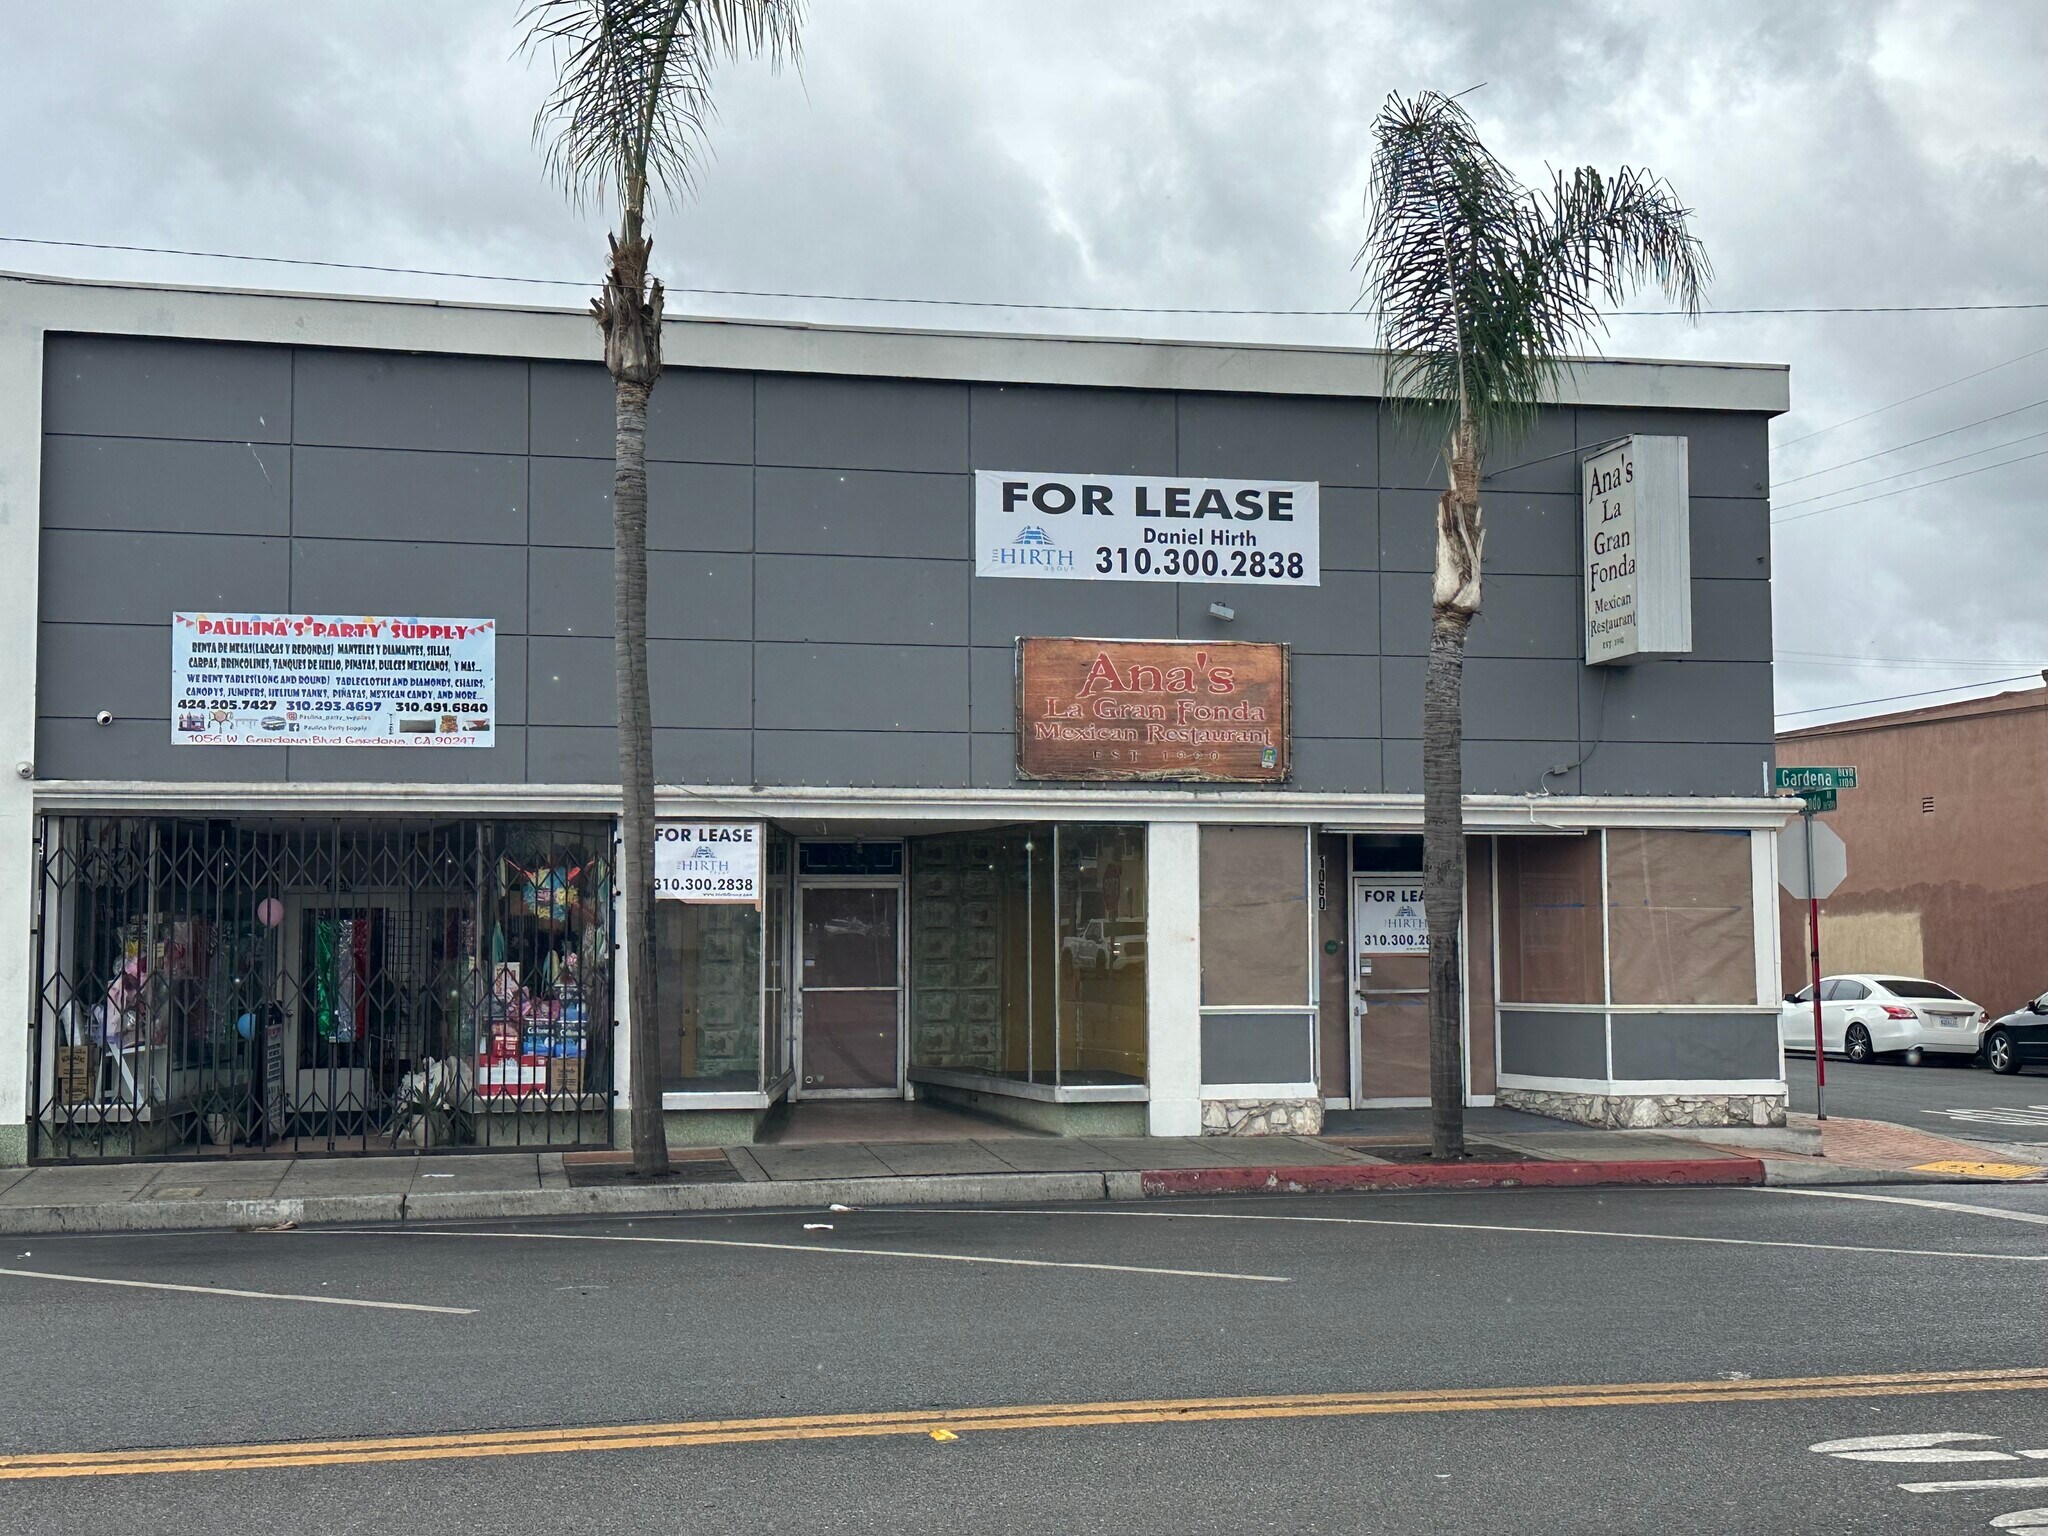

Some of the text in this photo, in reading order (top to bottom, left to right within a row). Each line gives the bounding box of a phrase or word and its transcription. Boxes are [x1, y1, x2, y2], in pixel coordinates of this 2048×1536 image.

[1589, 454, 1633, 504] Ana's
[1002, 481, 1294, 522] FOR LEASE
[1601, 498, 1621, 524] La
[1143, 527, 1257, 547] Daniel Hirth
[1594, 529, 1630, 555] Gran
[1001, 548, 1073, 565] HIRTH
[1095, 546, 1304, 579] 310.300.2838
[1590, 553, 1636, 593] Fonda
[1594, 594, 1632, 615] Mexican
[198, 620, 468, 639] PAULINA'S PARTY SUPPLY
[1590, 610, 1636, 637] Restaurant
[192, 642, 217, 653] RENTA
[218, 642, 228, 653] DE
[285, 644, 290, 654] Y
[292, 644, 334, 656] REDONDAS)
[337, 644, 374, 655] MANTELES
[376, 644, 381, 655] Y
[382, 645, 425, 657] DIAMANTES,
[427, 645, 452, 658] SILLAS,
[188, 657, 220, 669] CARPAS,
[220, 657, 272, 671] BRINCOLINES,
[273, 658, 306, 671] TANQUES
[308, 659, 318, 670] DE
[319, 659, 343, 672] HELIO,
[379, 660, 406, 671] DULCES
[407, 660, 451, 673] MEXICANOS,
[454, 660, 460, 671] Y
[187, 674, 200, 683] WE
[202, 674, 223, 683] RENT
[280, 675, 297, 684] AND
[299, 675, 330, 685] ROUND)
[336, 677, 391, 686] TABLECLOTHS
[392, 678, 408, 686] AND
[410, 678, 453, 688] DIAMONDS,
[455, 678, 485, 688] CHAIRS,
[1075, 651, 1235, 699] Ana's
[186, 687, 226, 697] CANOPYS,
[227, 687, 266, 698] JUMPERS,
[268, 688, 300, 698] HELIUM
[301, 689, 329, 699] TANKS,
[407, 690, 435, 700] CANDY,
[437, 690, 453, 699] AND
[177, 699, 488, 713] 424.205.7427 310.293.4697 310.491.6840
[1042, 696, 1265, 725] La Gran Fonda
[187, 734, 222, 743] 1056
[226, 735, 238, 743] W
[246, 735, 308, 744] Gardena
[313, 735, 342, 744] Blvd
[414, 736, 431, 745] CA
[436, 736, 475, 745] 90247
[1034, 722, 1274, 747] Mexican Restaurant
[1092, 749, 1142, 762] EST
[1782, 769, 1832, 787] Gardena
[1837, 768, 1854, 777] BLVD
[654, 828, 753, 842] FOR LEASE
[682, 860, 728, 871] HIRTH
[654, 878, 753, 891] 310.300.2838
[1364, 890, 1395, 902] FOR
